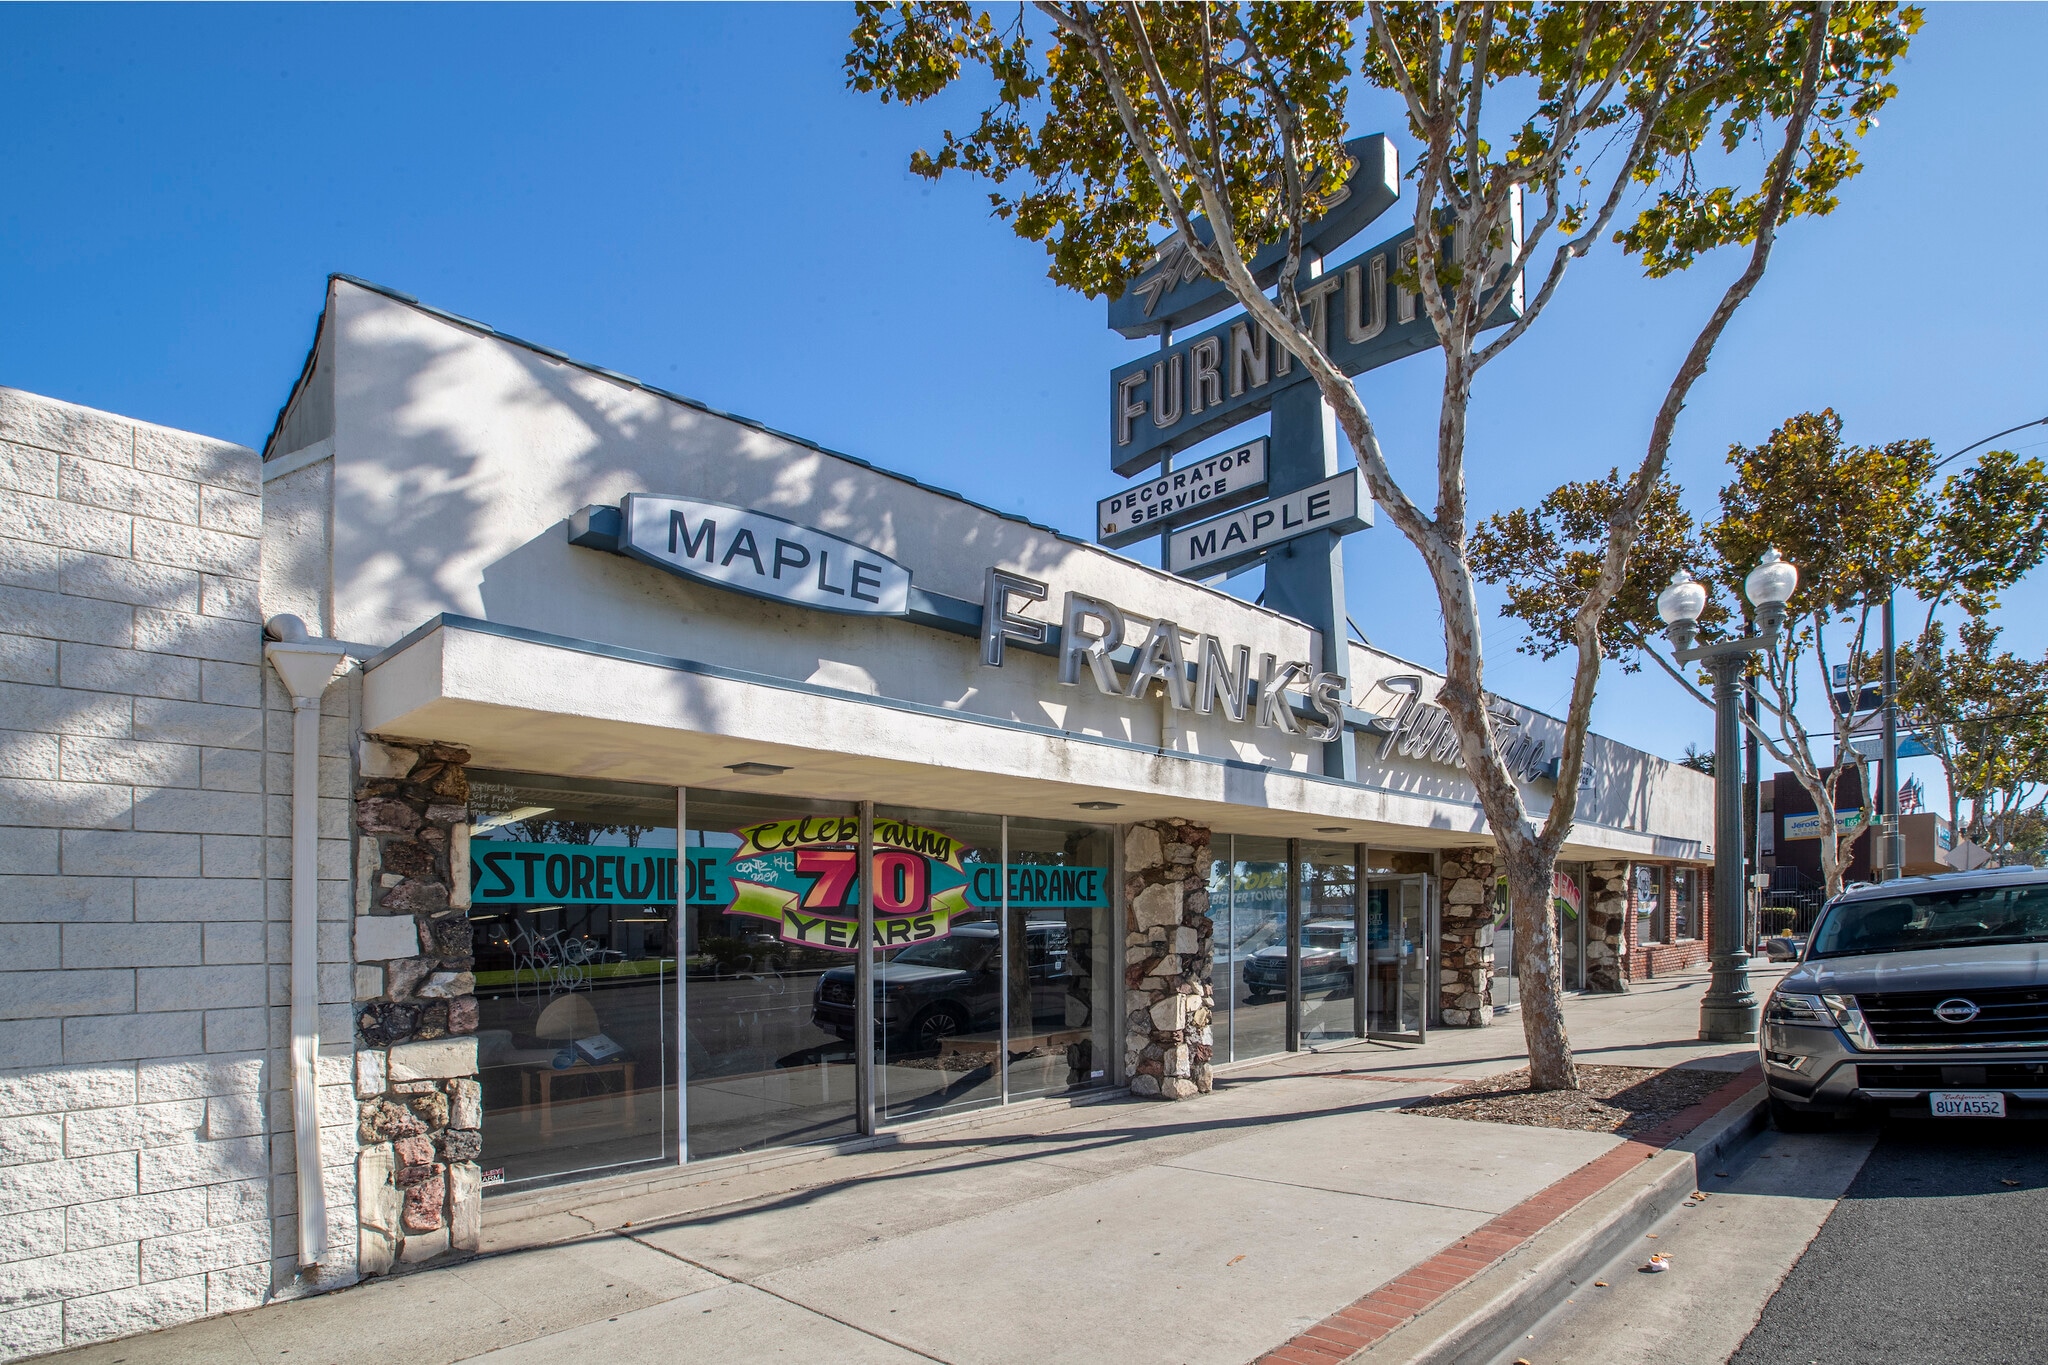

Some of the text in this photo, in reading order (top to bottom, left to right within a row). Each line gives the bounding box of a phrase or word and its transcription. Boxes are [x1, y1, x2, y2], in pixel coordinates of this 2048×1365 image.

[1110, 448, 1251, 515] DECORATOR
[1130, 478, 1227, 525] SERVICE
[1190, 489, 1331, 562] MAPLE
[668, 509, 883, 605] MAPLE
[483, 851, 716, 902] STOREWIDE
[796, 848, 931, 918] 70
[973, 867, 1098, 902] CLEARANCE
[783, 909, 936, 949] YEARS
[1934, 1007, 1979, 1015] NISSAN
[1936, 1101, 2000, 1114] 8UYA552
